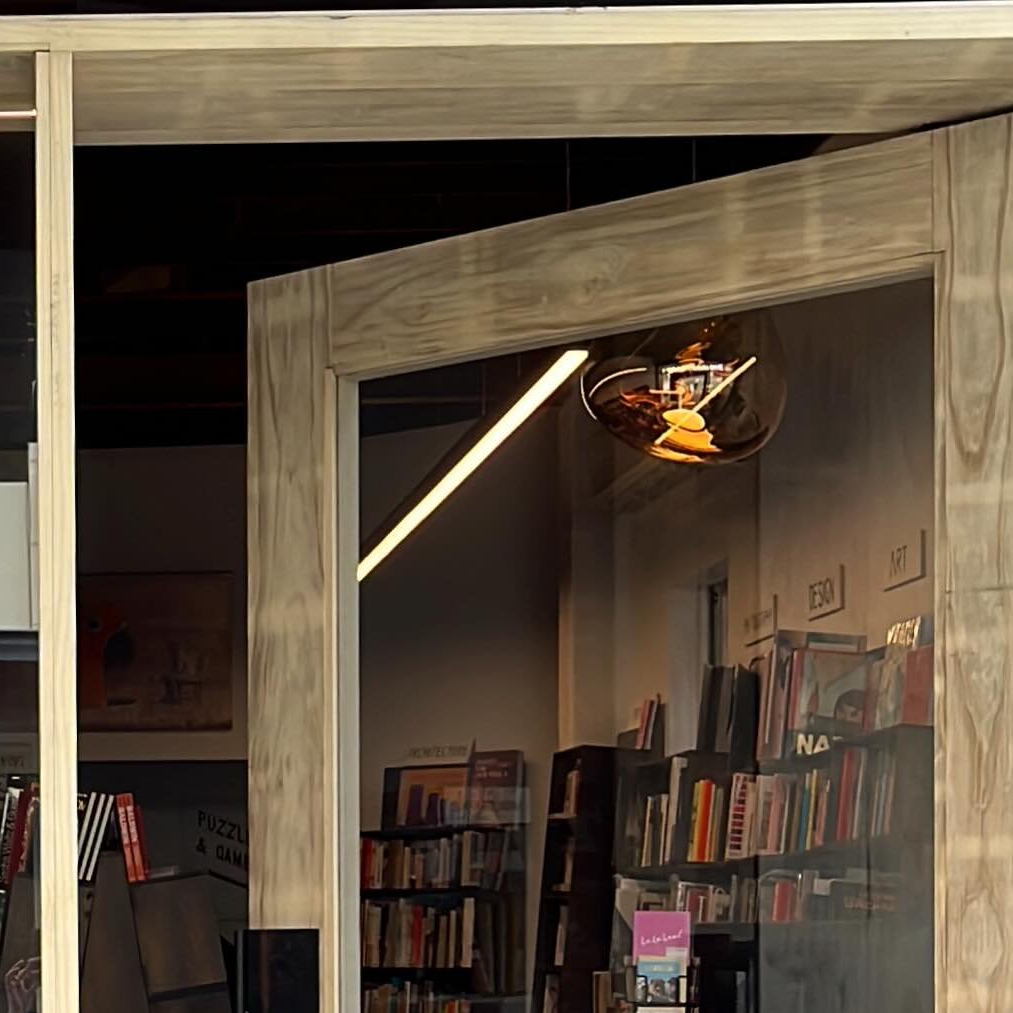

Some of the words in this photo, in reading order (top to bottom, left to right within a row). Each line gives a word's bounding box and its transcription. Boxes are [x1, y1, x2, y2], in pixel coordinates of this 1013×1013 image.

[890, 545, 907, 579] ART
[198, 810, 246, 844] PUZZL
[216, 844, 246, 868] GAM
